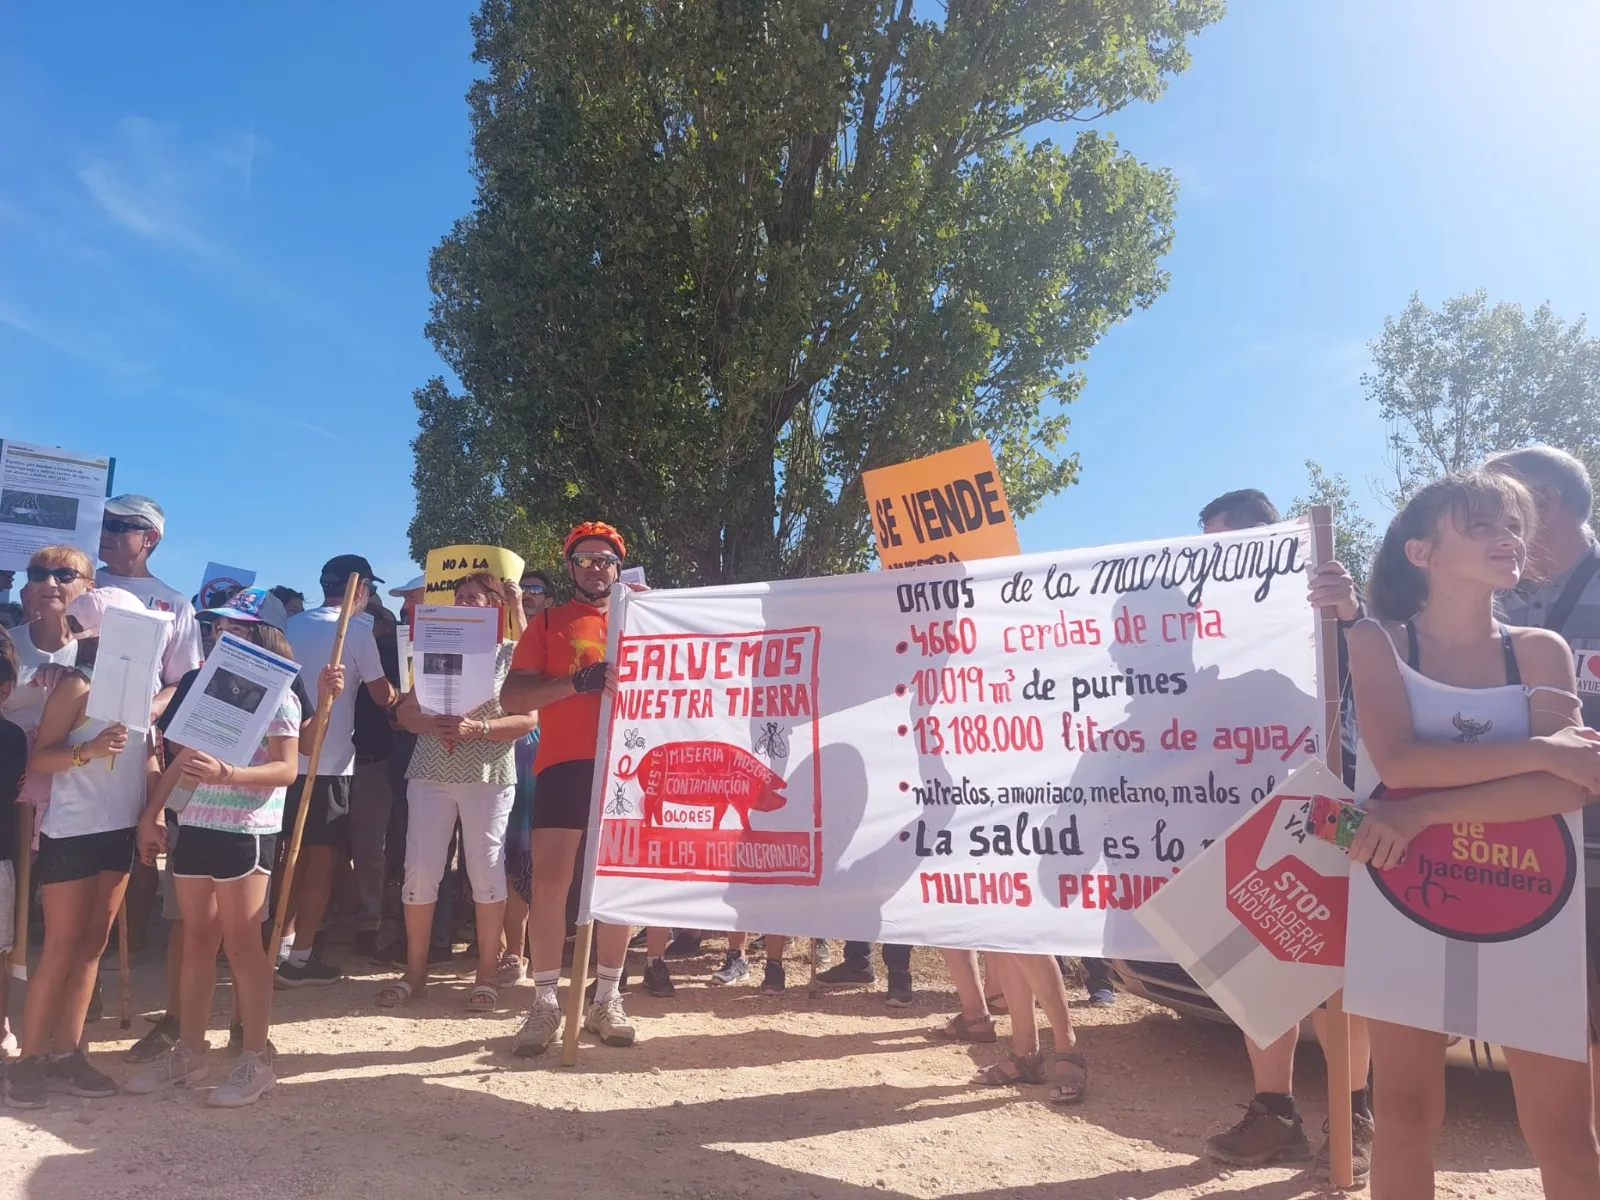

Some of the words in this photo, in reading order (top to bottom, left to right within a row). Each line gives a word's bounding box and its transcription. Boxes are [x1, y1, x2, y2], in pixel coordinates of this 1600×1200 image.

[876, 497, 903, 549] SE
[902, 470, 1006, 544] VENDE
[442, 558, 457, 571] NO
[458, 557, 468, 569] A
[472, 557, 489, 569] LA
[897, 577, 975, 613] DATOS
[1001, 571, 1033, 604] de
[1043, 563, 1080, 601] la
[1090, 536, 1305, 607] macrogranja
[1003, 609, 1101, 654] cerdas
[1114, 605, 1147, 645] de
[618, 636, 805, 683] SALVEMOS
[615, 688, 714, 720] NUESTRA
[725, 683, 811, 718] TIERRA
[910, 666, 985, 706] 10.019
[1022, 667, 1056, 701] de
[1072, 667, 1188, 713] purines
[913, 714, 1044, 755] 13.188.000
[1061, 711, 1146, 753] litros
[1160, 717, 1198, 751] de
[645, 750, 664, 796] PESTE
[732, 750, 775, 785] MOSCAS
[911, 776, 995, 808] nitratos,
[1090, 775, 1169, 807] metano,
[1172, 769, 1240, 805] malos
[1250, 774, 1276, 805] ol
[663, 807, 712, 824] OLORES
[915, 819, 954, 857] La
[968, 811, 1085, 857] salud
[1102, 836, 1140, 859] es
[1151, 818, 1185, 863] lo
[598, 820, 641, 867] NO
[646, 839, 661, 866] A
[668, 840, 696, 867] LAS
[704, 840, 810, 871] MACROGRANJAS
[1451, 836, 1542, 874] SORIA
[919, 871, 1033, 907] MUCHOS
[1273, 871, 1331, 921] STOP
[1417, 852, 1553, 896] hacendera
[1229, 870, 1308, 963] INDUSTRIAL
[1247, 877, 1325, 956] GANADERÍA
